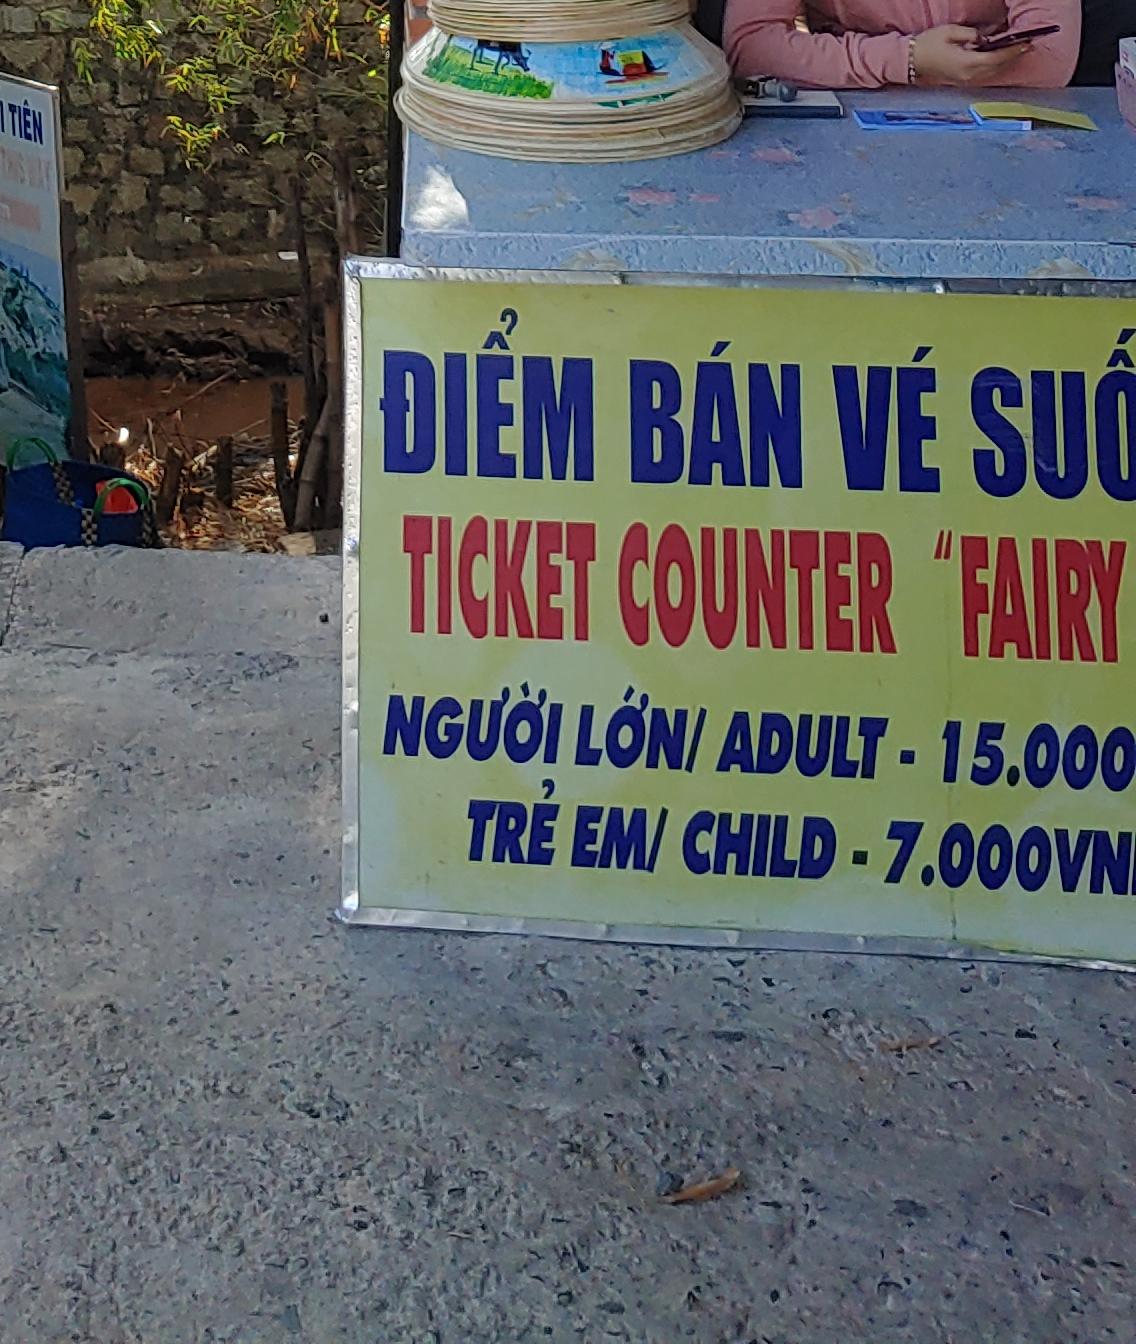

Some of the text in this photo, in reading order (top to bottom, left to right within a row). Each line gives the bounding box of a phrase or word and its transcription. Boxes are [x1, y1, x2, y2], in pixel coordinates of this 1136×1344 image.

[8, 99, 44, 145] TIÊN
[380, 308, 595, 482] ĐIỂM
[629, 340, 803, 490] BÁN
[832, 346, 941, 494] VÉ
[402, 515, 597, 641] TICKET
[618, 522, 898, 655] COUNTER
[382, 681, 561, 766] NGƯỜI
[716, 712, 889, 780] ADULT
[468, 780, 560, 867] TRẺ
[682, 810, 837, 880] CHILD
